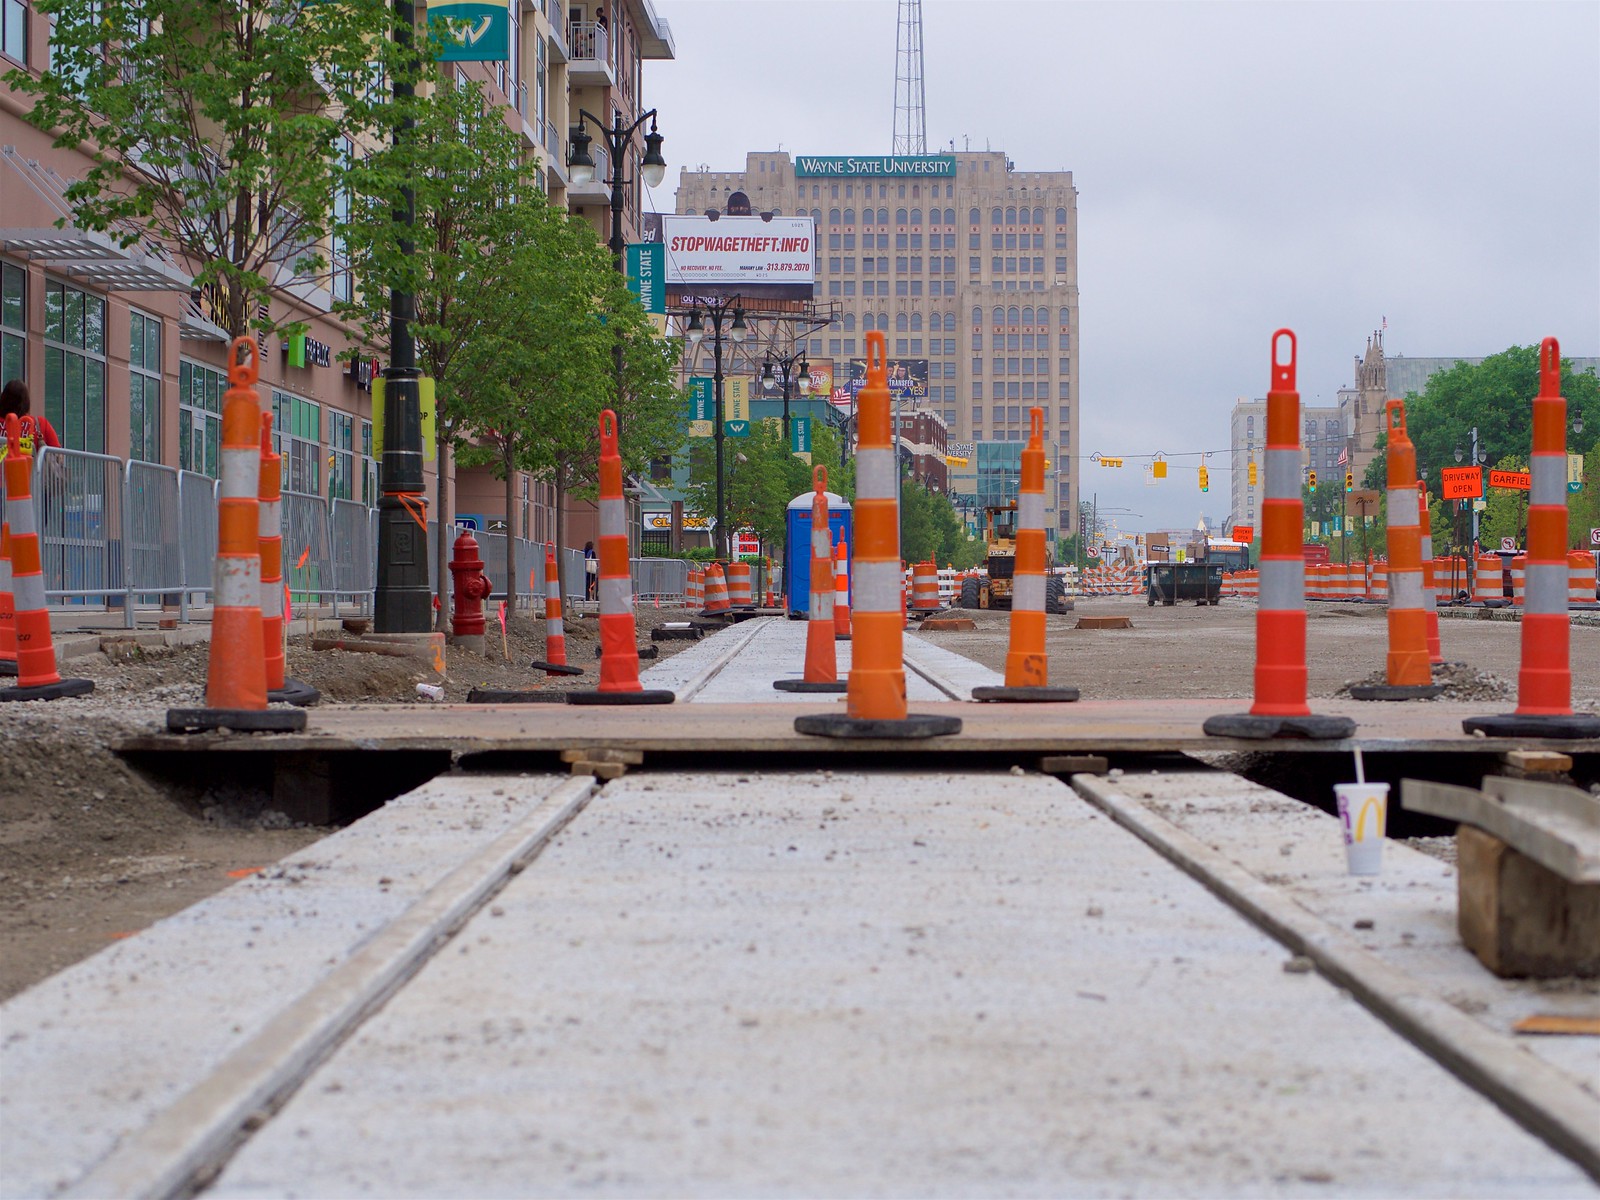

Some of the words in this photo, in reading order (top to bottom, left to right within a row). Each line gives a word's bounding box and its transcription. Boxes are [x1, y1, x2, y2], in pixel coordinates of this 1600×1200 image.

[801, 158, 844, 173] WAYNE
[847, 158, 881, 173] STATE
[883, 158, 951, 173] UNIVERSITY
[670, 236, 809, 252] STOPWAGETHEFT.INFO
[640, 249, 652, 277] STATE
[766, 262, 810, 271] 313.879.2070
[811, 375, 826, 385] TAP
[888, 379, 914, 387] TRANSFER
[909, 386, 925, 396] YES!
[955, 442, 974, 451] STATE
[1444, 472, 1480, 482] DRIVEWAY
[1493, 475, 1531, 486] GARFIEL
[1453, 485, 1473, 493] OPEN
[652, 517, 708, 528] CLSSIC
